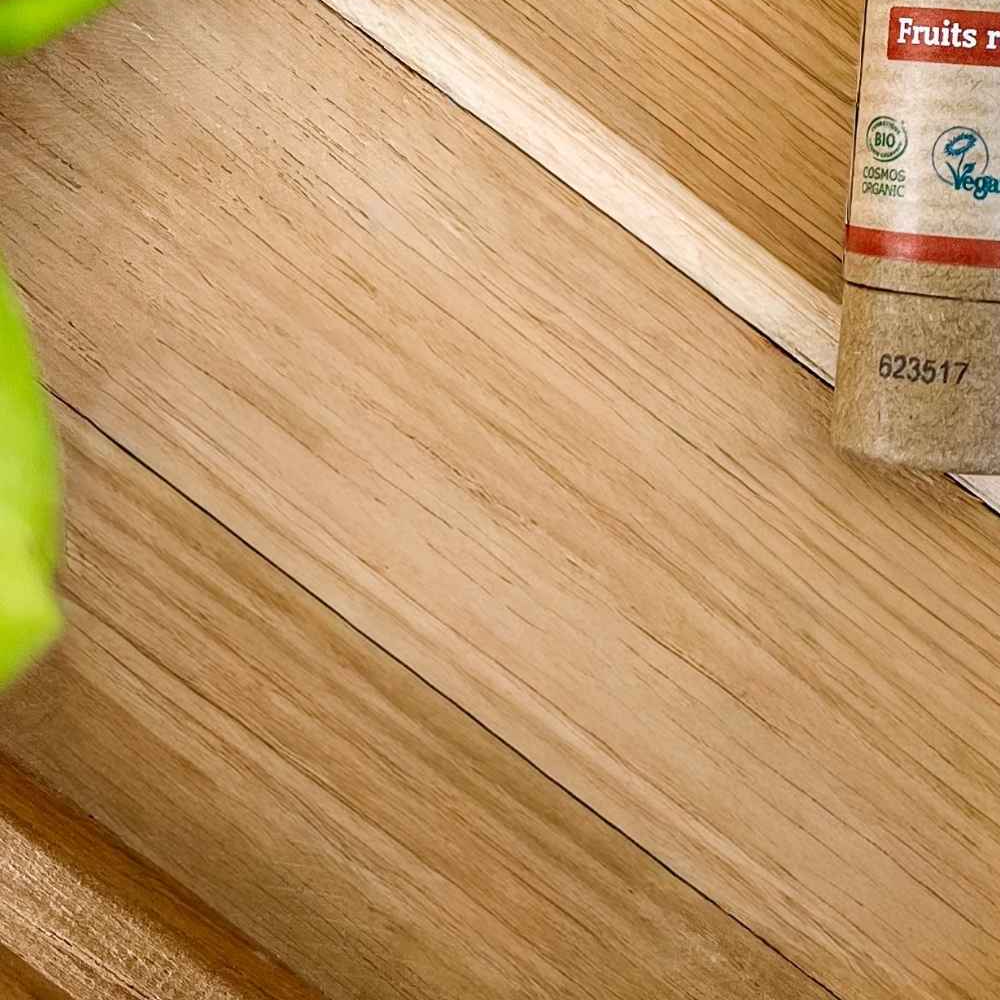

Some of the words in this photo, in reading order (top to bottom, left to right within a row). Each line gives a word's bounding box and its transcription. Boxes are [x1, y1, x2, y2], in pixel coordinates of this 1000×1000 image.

[897, 17, 977, 48] Fruits
[874, 131, 896, 148] BIO
[863, 166, 906, 182] COSMOS
[862, 181, 905, 198] ORGANIC
[879, 353, 971, 384] 623517
